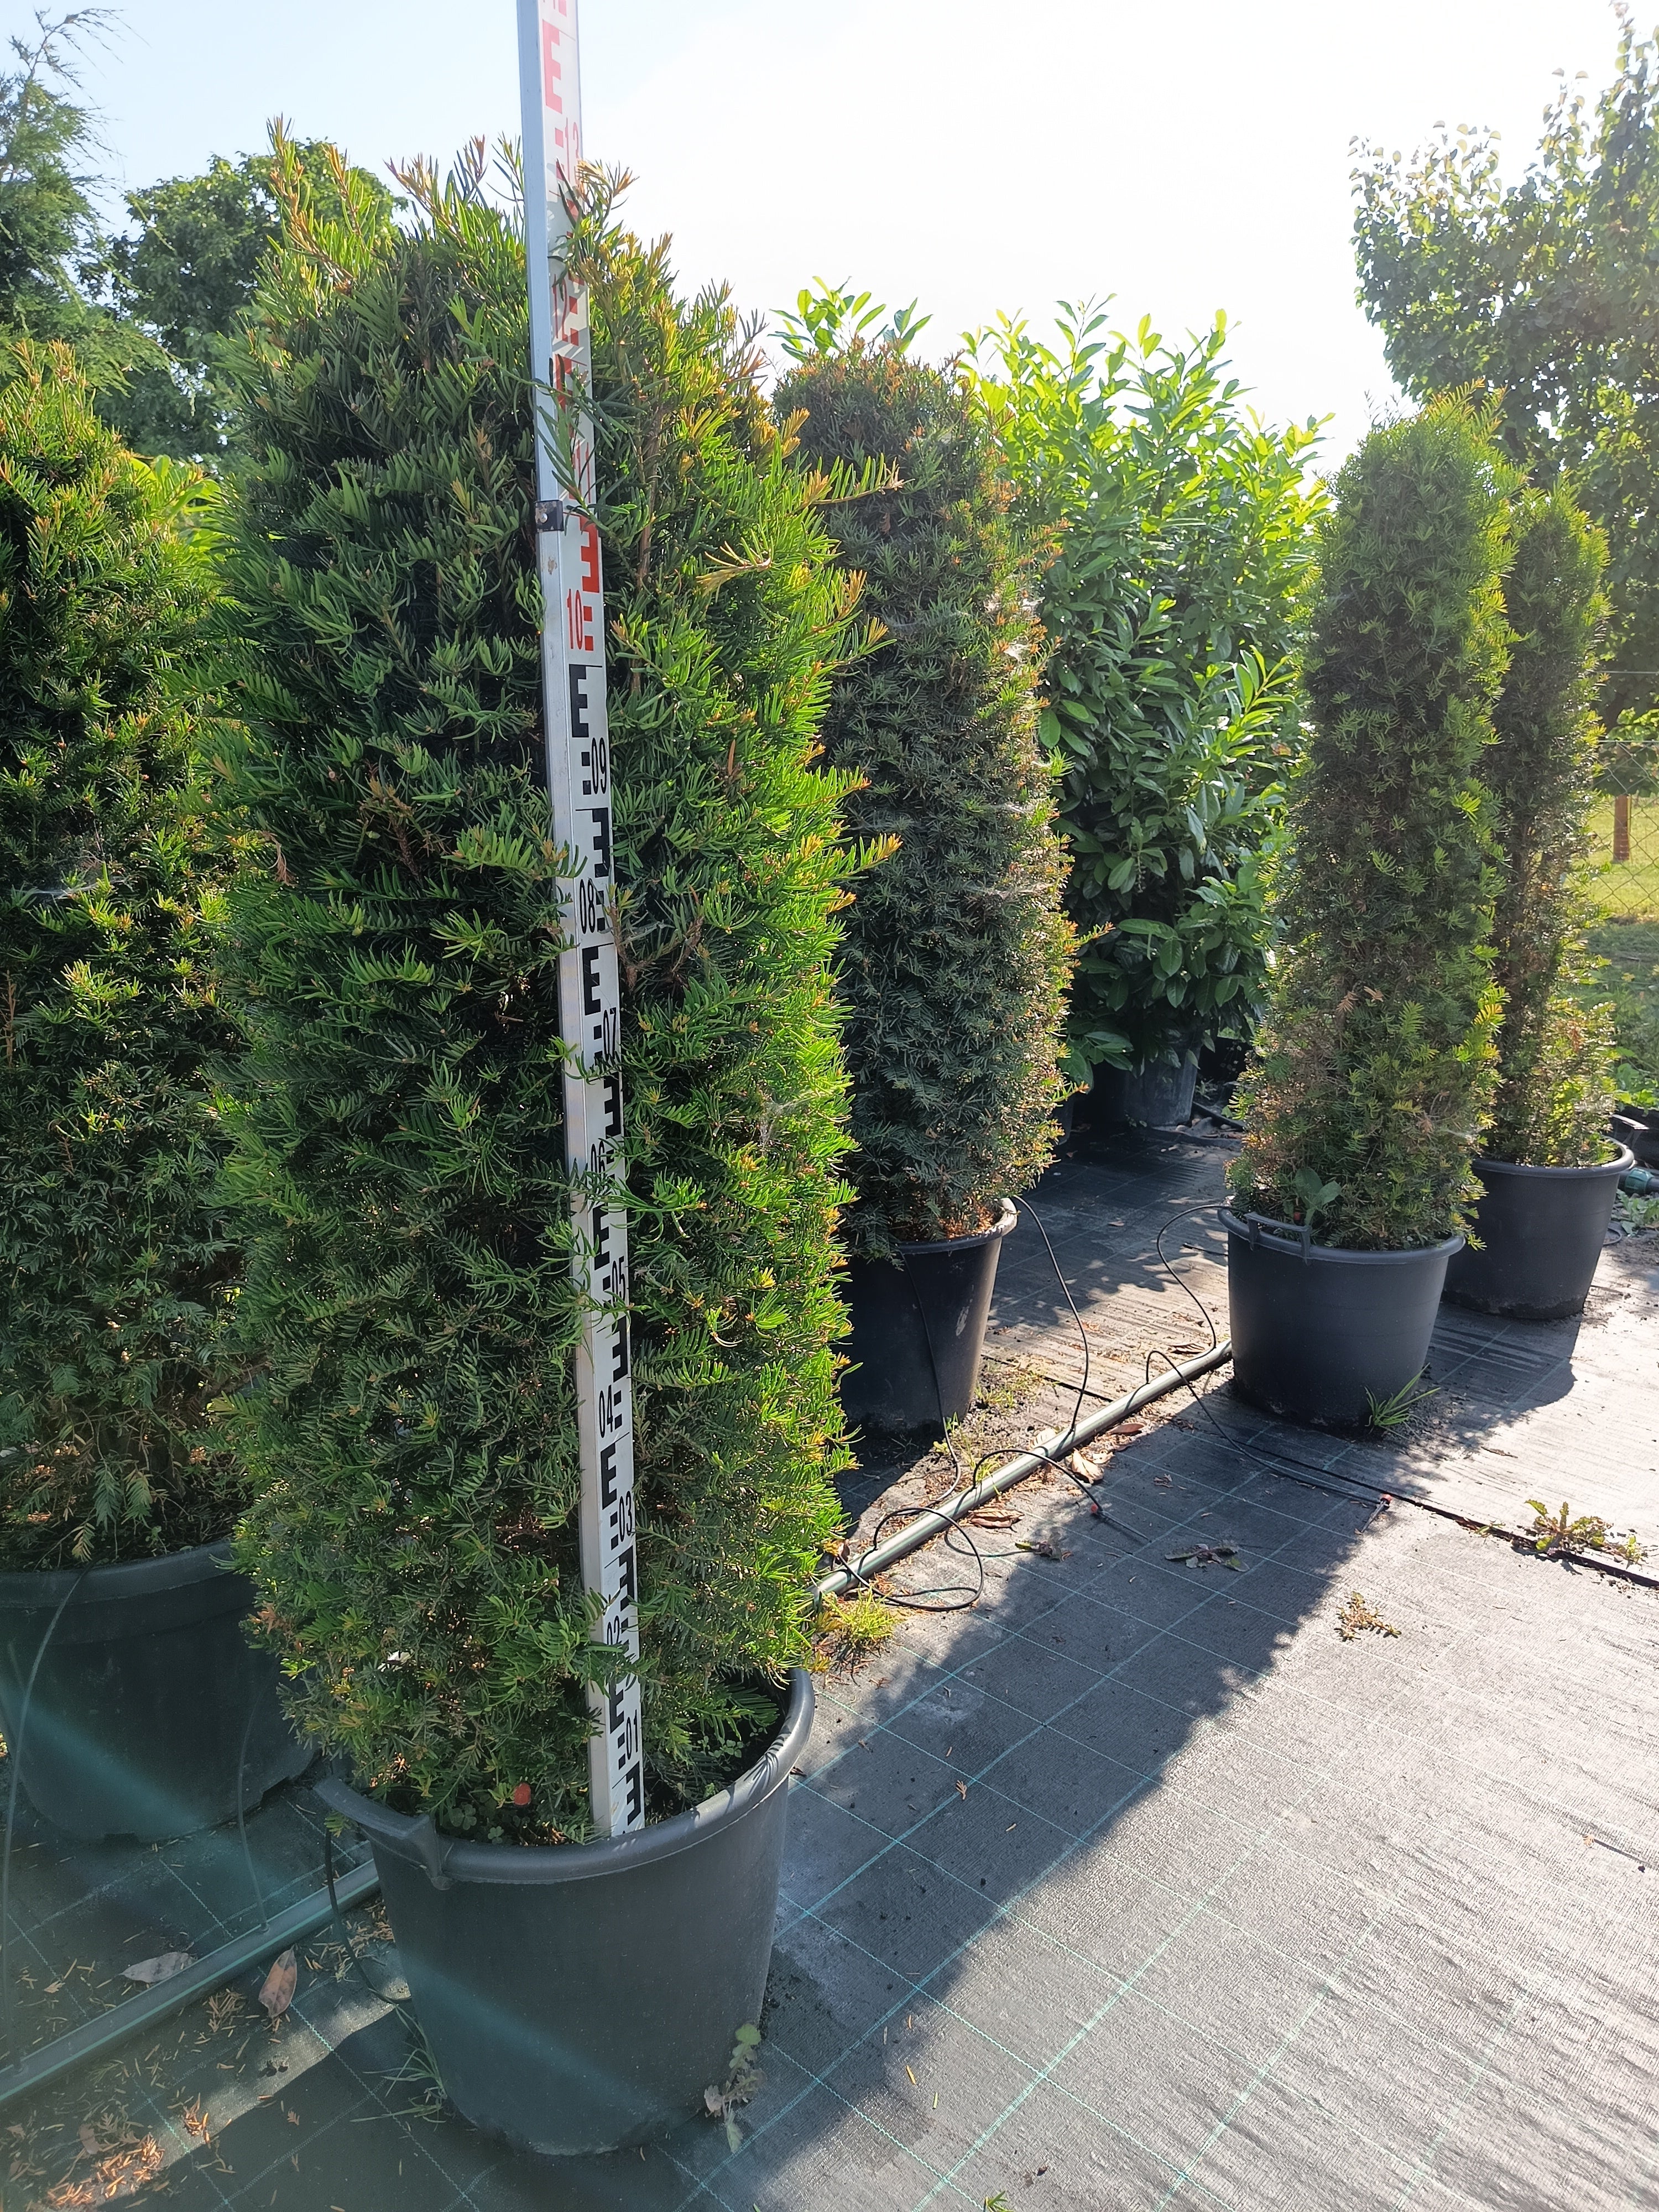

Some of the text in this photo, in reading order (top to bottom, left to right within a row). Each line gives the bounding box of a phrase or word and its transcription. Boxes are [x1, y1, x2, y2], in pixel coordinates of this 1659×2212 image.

[552, 274, 568, 342] 12
[577, 440, 591, 503] 11
[567, 588, 583, 650] 10
[592, 738, 607, 794] 09
[580, 878, 595, 934] 08
[603, 1007, 616, 1061] 07
[612, 1256, 625, 1306] 05
[599, 1385, 613, 1438] 04
[619, 1491, 632, 1542] 03
[626, 1709, 638, 1760] 01
